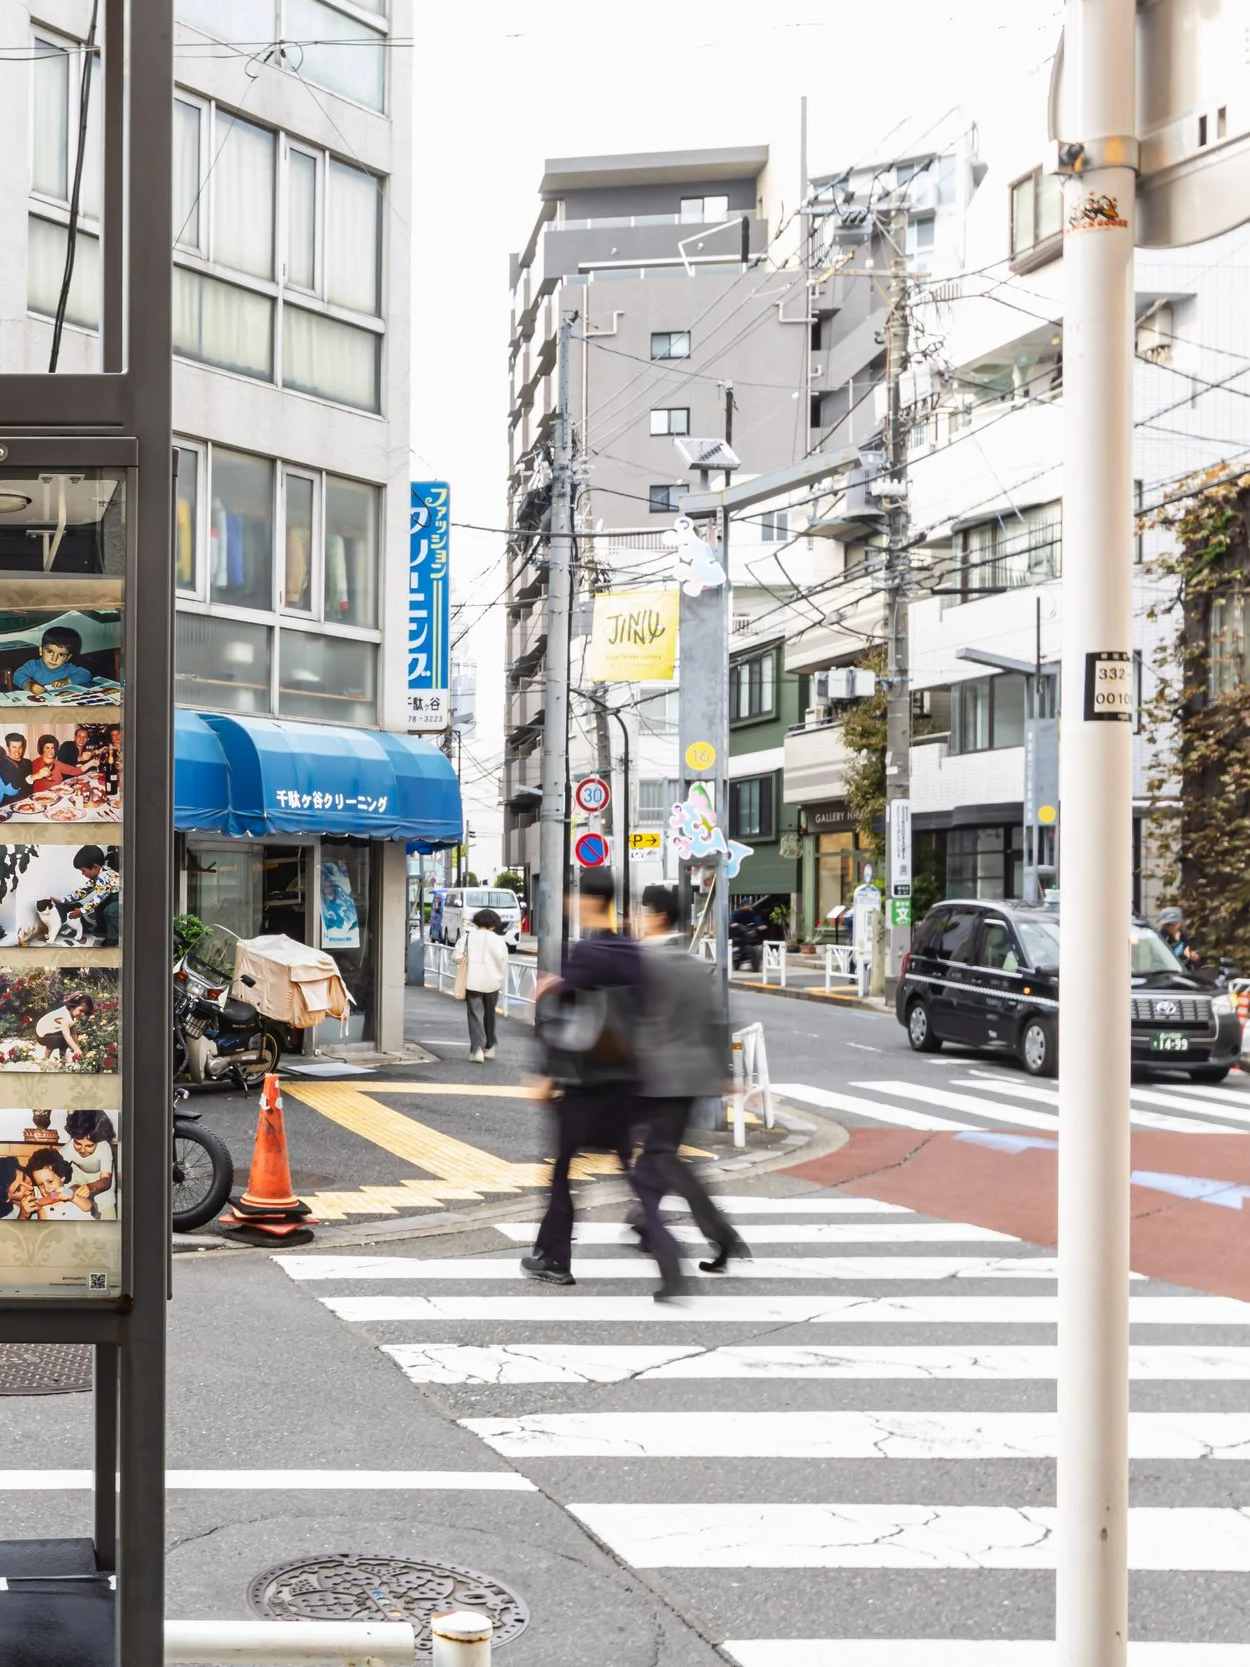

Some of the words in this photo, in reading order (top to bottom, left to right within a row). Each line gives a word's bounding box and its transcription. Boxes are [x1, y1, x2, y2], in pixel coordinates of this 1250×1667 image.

[425, 488, 448, 579] ファッション
[583, 787, 602, 803] 30
[815, 811, 845, 824] GALLERY
[633, 834, 643, 847] P
